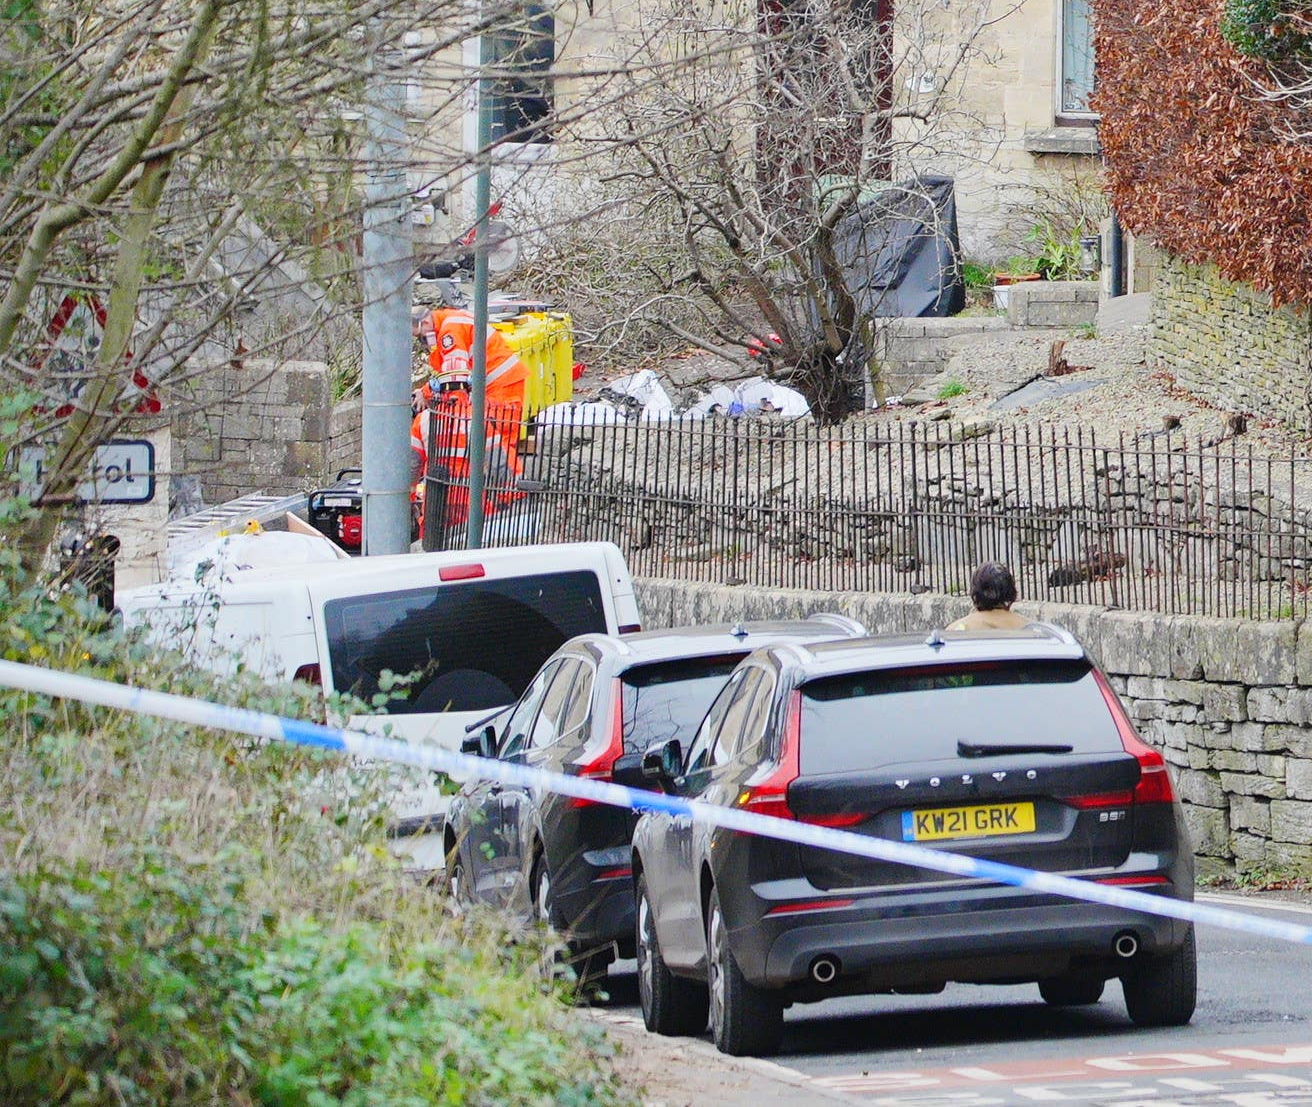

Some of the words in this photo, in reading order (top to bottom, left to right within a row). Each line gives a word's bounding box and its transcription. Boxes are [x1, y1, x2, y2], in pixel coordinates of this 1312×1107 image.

[895, 769, 1037, 789] VOLVO
[916, 810, 968, 834] KW21
[974, 807, 1019, 830] GRK
